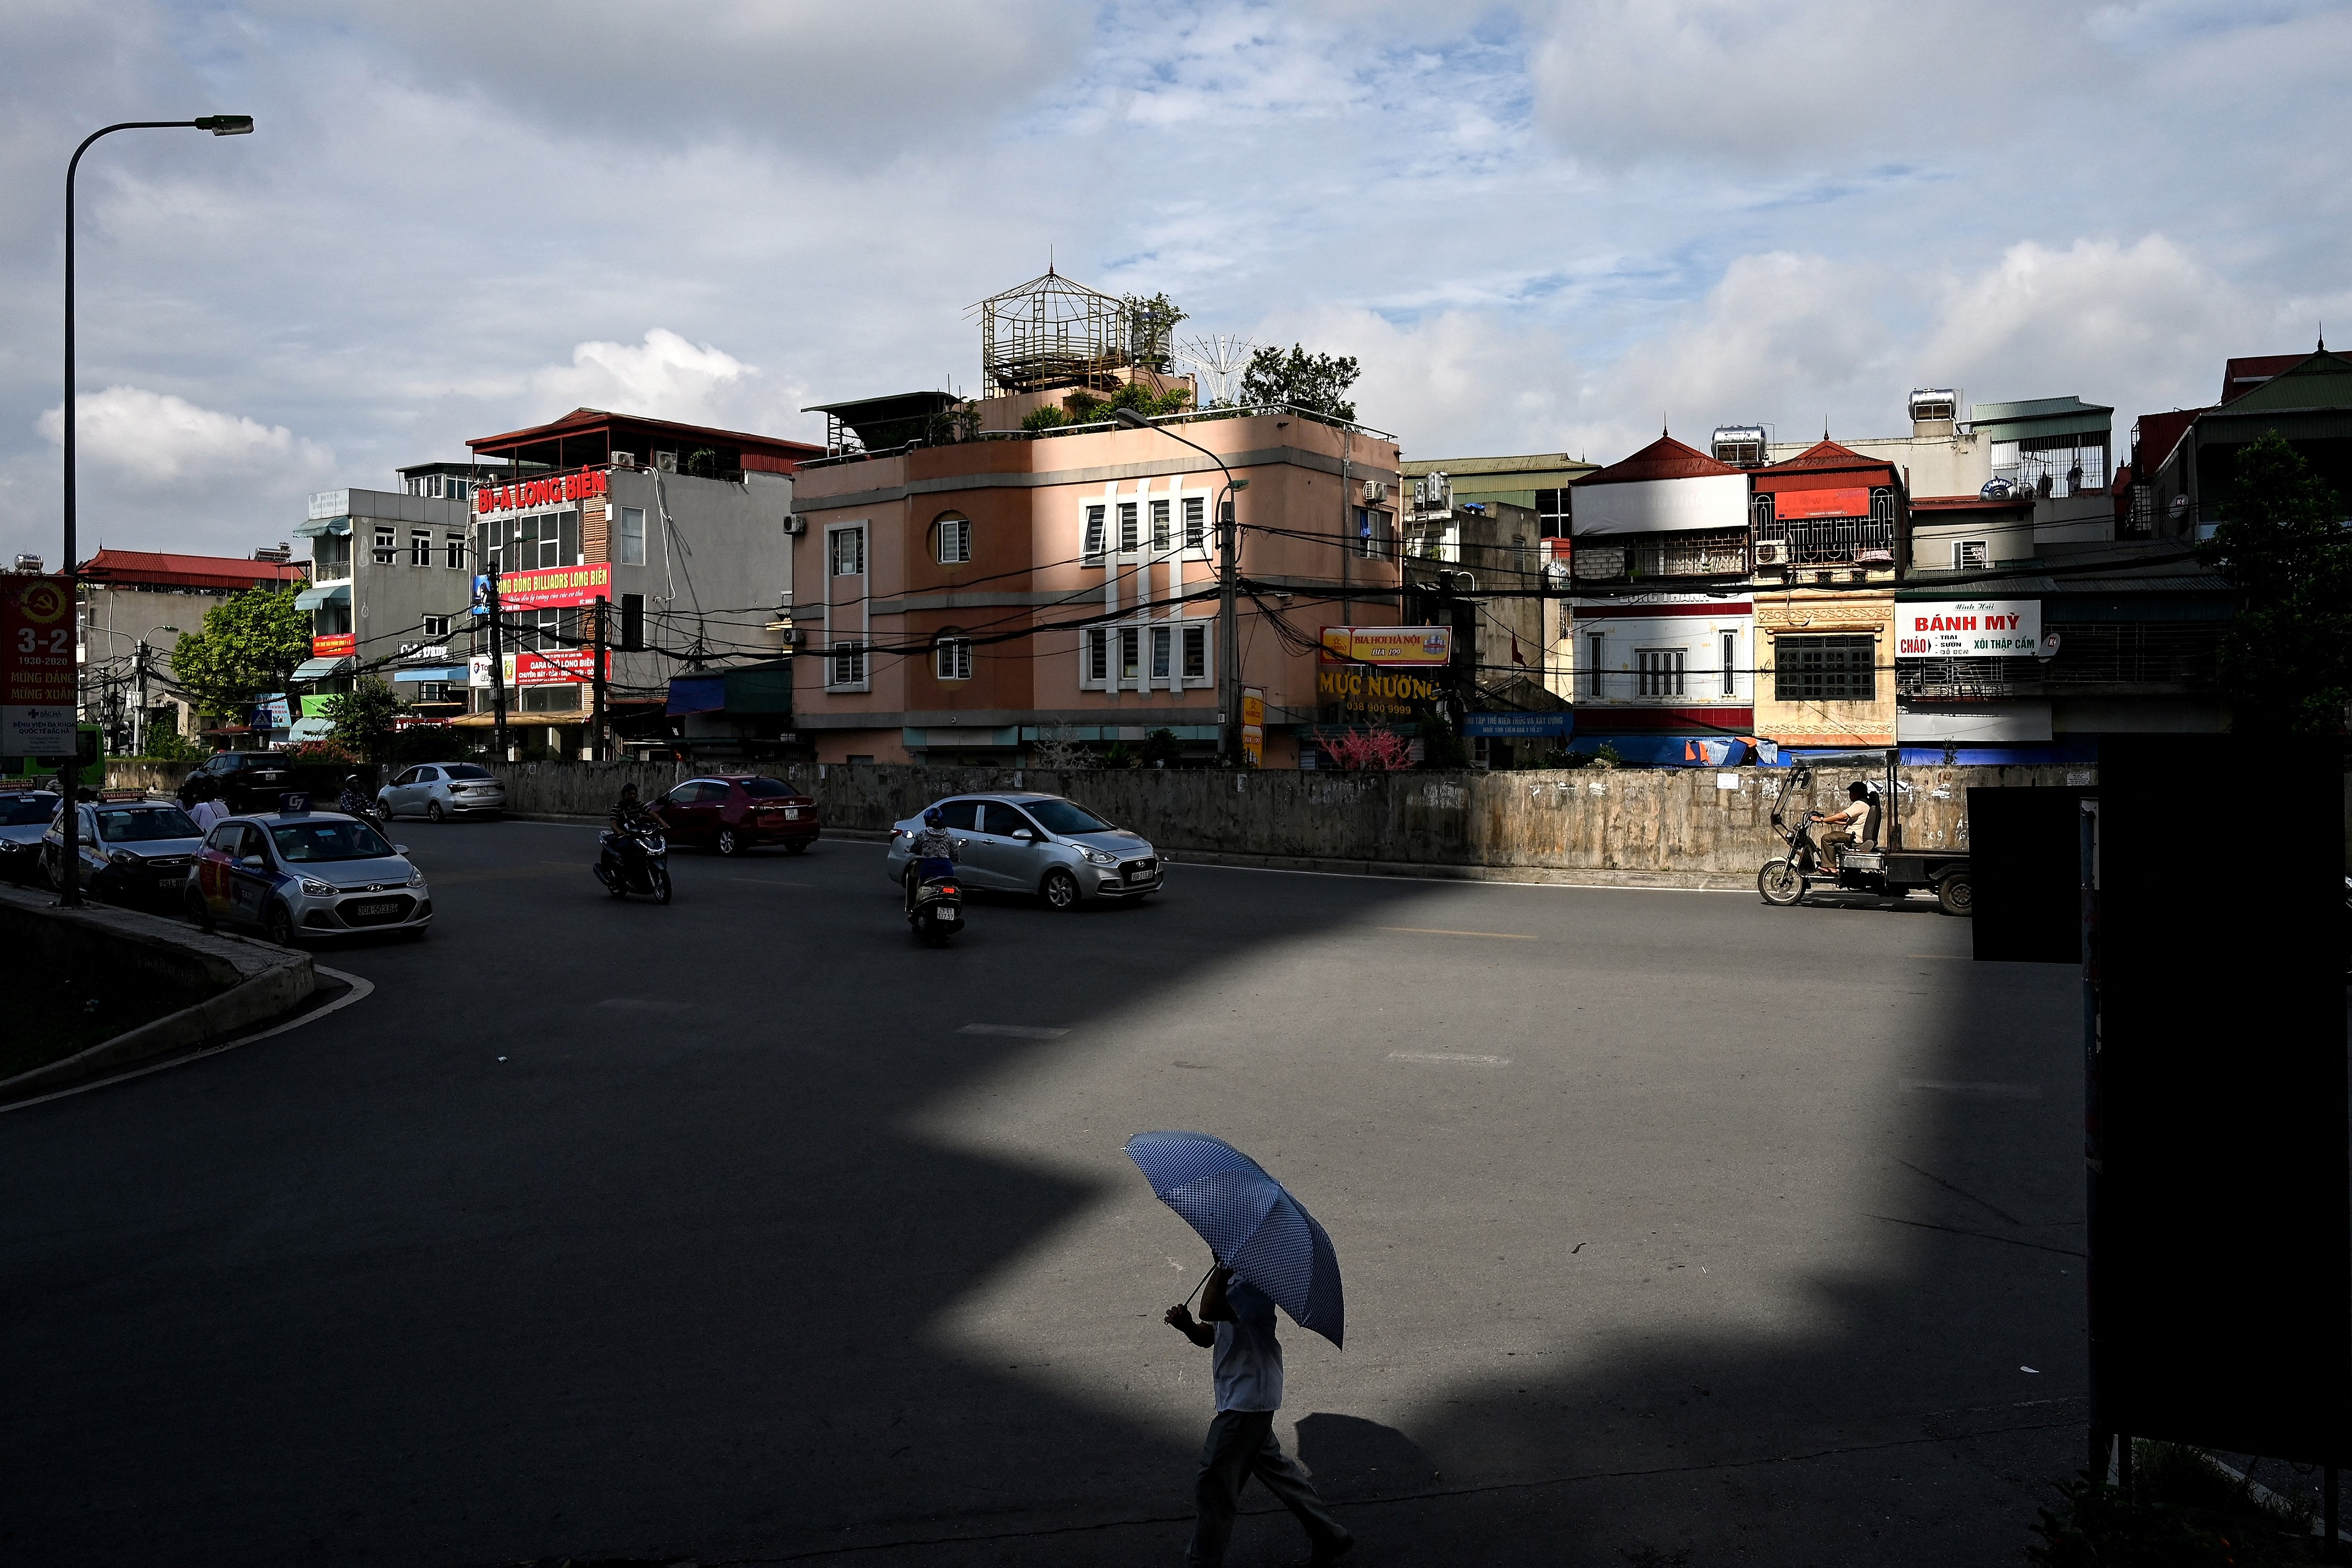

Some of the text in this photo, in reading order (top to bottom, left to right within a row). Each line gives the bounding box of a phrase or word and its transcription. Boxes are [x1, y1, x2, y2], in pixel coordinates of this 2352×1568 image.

[515, 477, 563, 509] LONG
[565, 464, 607, 502] BIÊN
[513, 572, 532, 593] ĐỒNG
[533, 573, 569, 592] BILLIADRS
[570, 571, 589, 588] LONG
[591, 566, 607, 586] BIÊN
[1915, 612, 2020, 631] BÁNH MỲ
[18, 628, 67, 653] 3-2
[1354, 636, 1369, 644] BIA
[1371, 636, 1388, 644] HƠI
[1389, 634, 1403, 644] HÀ
[1404, 634, 1421, 646] NỘI
[1900, 636, 1926, 653] CHÁO
[1974, 635, 2035, 651] XÔI THẬP CẨM
[19, 656, 67, 665] 1930-2020
[561, 659, 579, 668] LONG
[579, 658, 595, 667] BIÊN
[11, 670, 75, 684] MỪNG ĐẢNG
[1319, 670, 1362, 699] MỰC
[11, 686, 75, 700] MỪNG XUÂN
[1346, 702, 1411, 715] 038 900 9999
[289, 795, 304, 810] G7
[241, 890, 253, 900] TAXI
